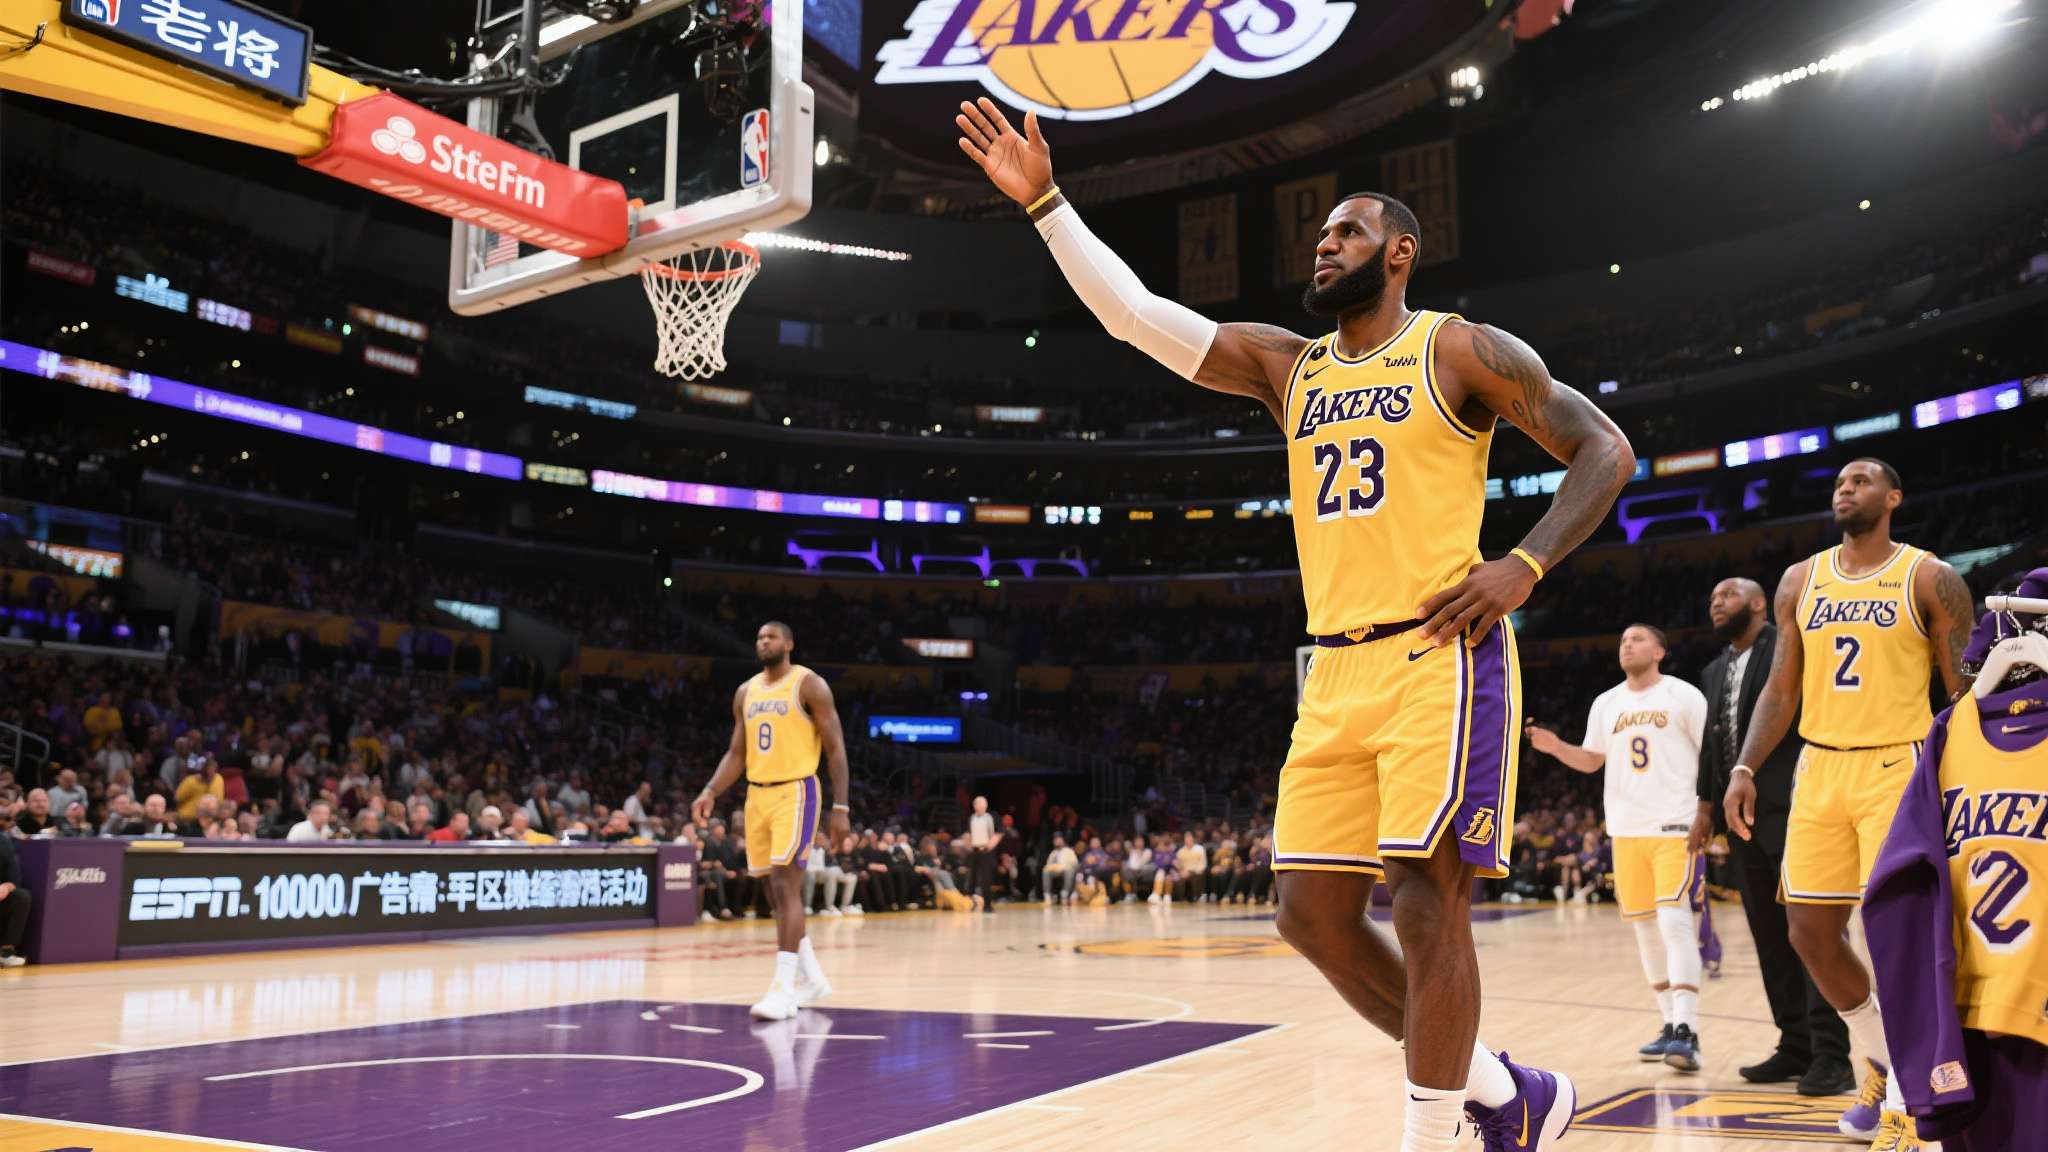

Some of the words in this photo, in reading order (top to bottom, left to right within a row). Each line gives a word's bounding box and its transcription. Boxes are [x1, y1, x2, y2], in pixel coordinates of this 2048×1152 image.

[1294, 384, 1414, 441] LAKERS
[1313, 437, 1386, 523] 23
[1805, 596, 1898, 631] LAKERS
[1834, 633, 1862, 690] 2
